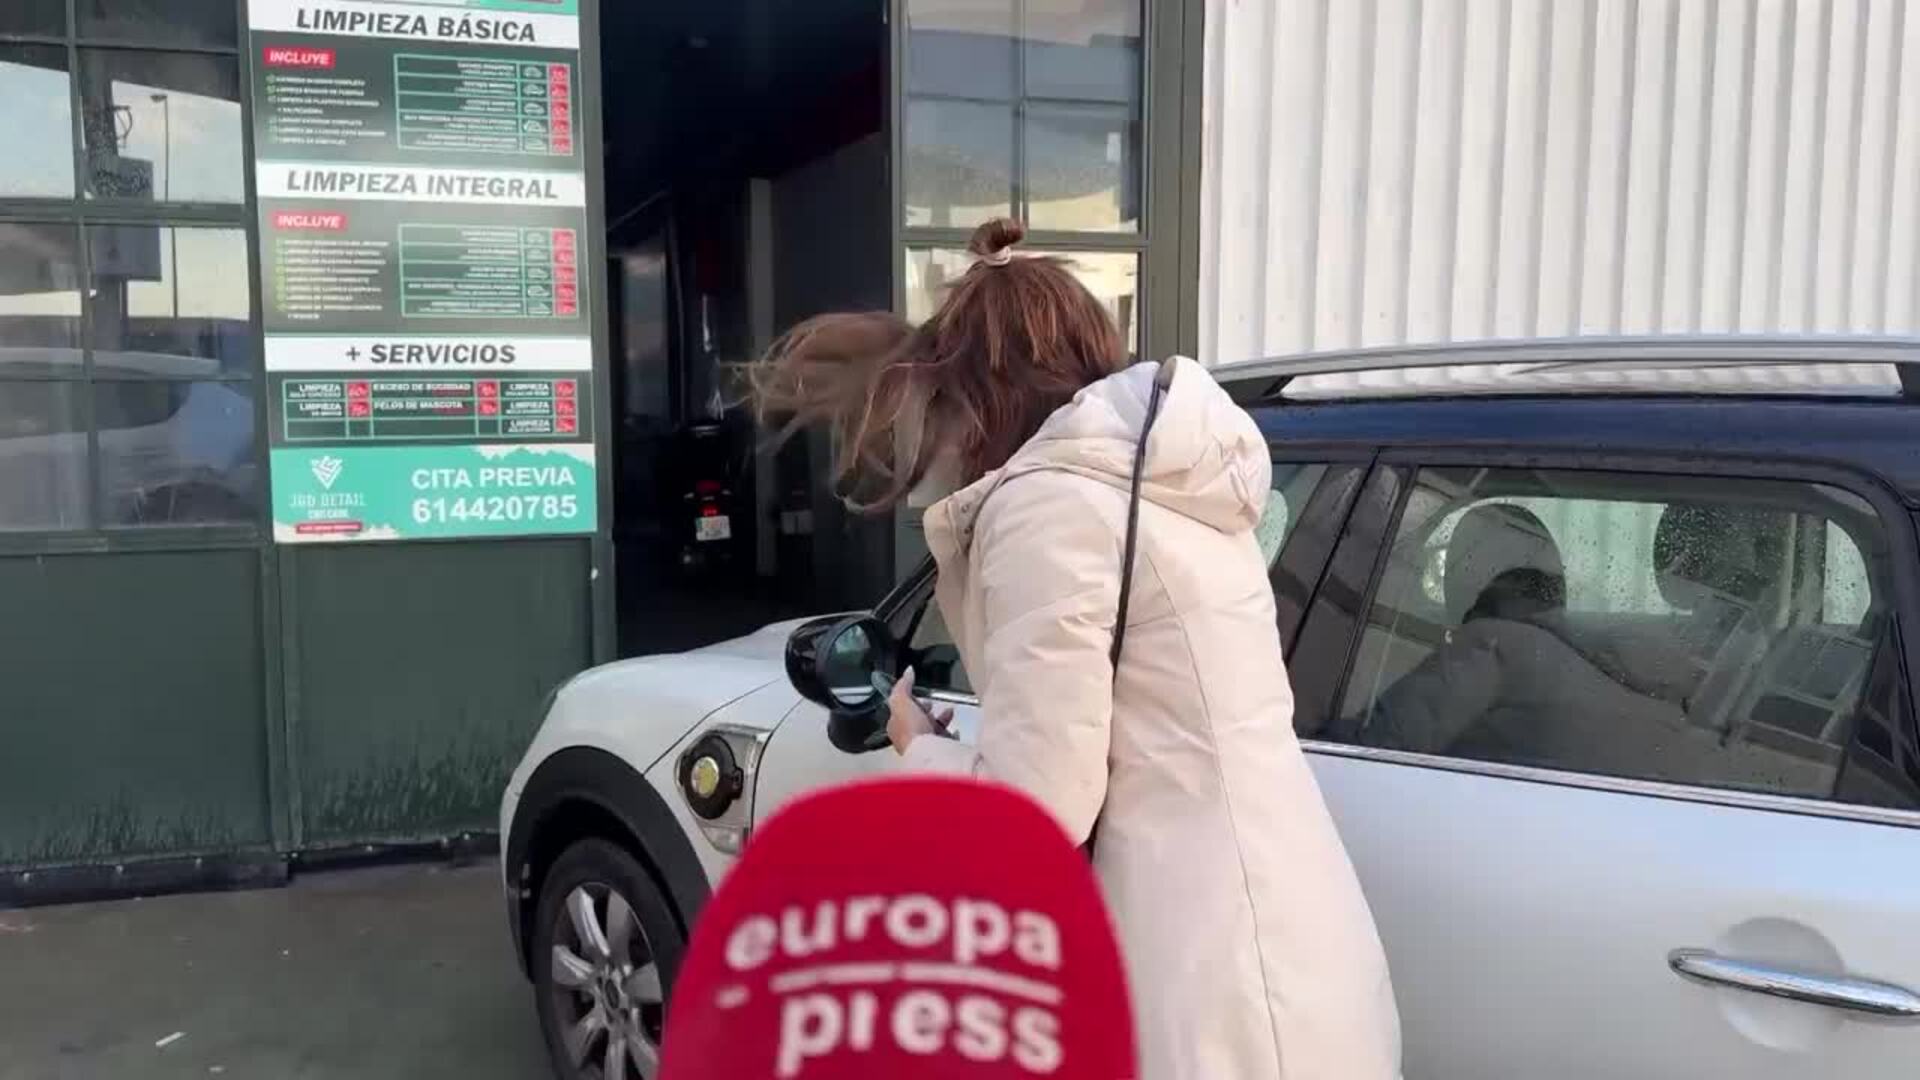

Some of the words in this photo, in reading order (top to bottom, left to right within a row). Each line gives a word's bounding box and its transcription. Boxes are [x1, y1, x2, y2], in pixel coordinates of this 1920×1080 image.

[296, 9, 428, 36] LIMPIEZA
[437, 13, 536, 42] BÁSICA
[269, 51, 330, 65] INCLUYE
[287, 170, 418, 194] LIMPIEZA
[427, 176, 559, 199] INTEGRAL
[277, 215, 342, 229] INCLUYE
[346, 347, 361, 362] +
[370, 344, 517, 365] SERVICIOS
[299, 384, 341, 392] LIMPIEZA
[373, 383, 410, 391] EXCESO
[412, 383, 425, 391] DE
[509, 383, 549, 391] LIMPIEZA
[299, 403, 342, 411] LIMPIEZA
[374, 402, 405, 410] PELOS
[406, 401, 418, 409] DE
[419, 401, 463, 409] MASCOTA
[510, 402, 549, 410] LIMPIEZA
[510, 420, 550, 428] LIMPIEZA
[412, 468, 473, 490] CITA
[479, 466, 577, 488] PREVIA
[321, 493, 368, 506] DETAIL
[412, 495, 578, 524] 614420785
[724, 892, 1063, 972] europa
[776, 989, 1063, 1080] press
